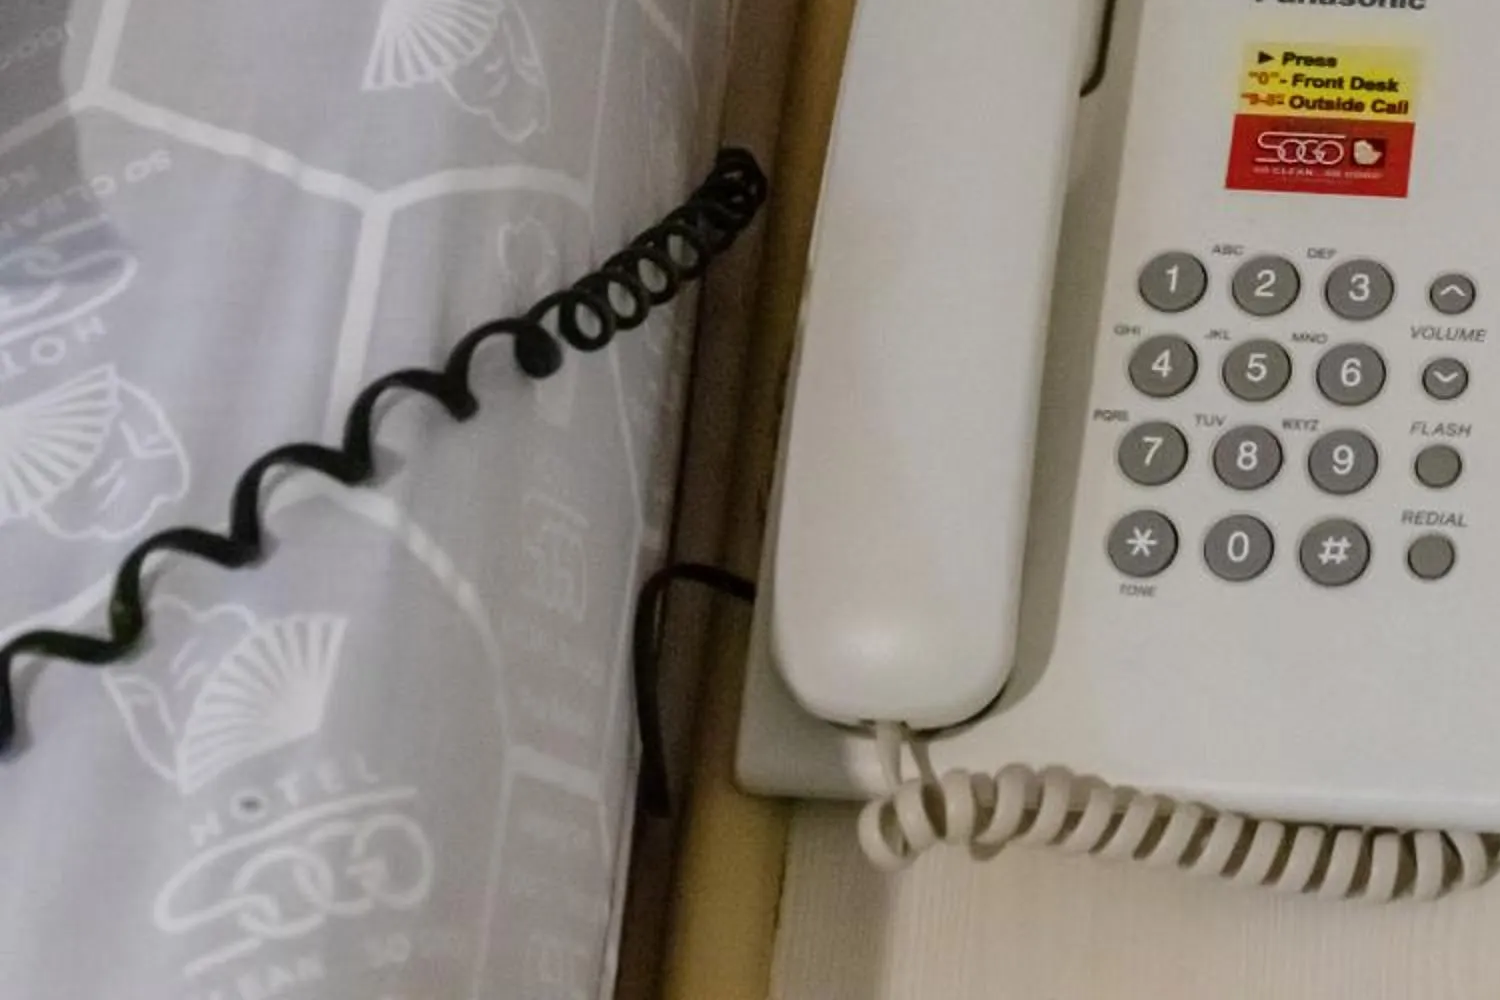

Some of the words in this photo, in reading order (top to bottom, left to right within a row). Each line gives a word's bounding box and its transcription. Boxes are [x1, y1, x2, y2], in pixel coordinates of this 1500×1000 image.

[1281, 51, 1338, 68] Press
[1291, 73, 1345, 90] Front
[1350, 76, 1399, 92] Desk
[1288, 95, 1365, 113] Outside
[1371, 99, 1409, 115] Call
[1254, 131, 1347, 165] SOGO
[1211, 243, 1245, 257] ABC
[1306, 247, 1337, 260] DEF
[1165, 264, 1180, 293] 1
[1255, 269, 1276, 297] 2
[1348, 273, 1370, 301] 3
[1113, 325, 1141, 337] GHI
[1204, 329, 1231, 341] JKL
[1291, 332, 1328, 344] MNO
[1410, 326, 1487, 343] VOLUME
[1151, 349, 1173, 378] 4
[1246, 353, 1267, 382] 5
[1340, 358, 1362, 387] 6
[1194, 414, 1226, 427] TUV
[1282, 419, 1320, 432] WXYZ
[1410, 421, 1472, 438] FLASH
[1142, 437, 1163, 466] 7
[1236, 441, 1258, 470] 8
[1332, 445, 1355, 474] 9
[1401, 510, 1468, 528] REDIAL
[1227, 531, 1250, 562] 0
[1119, 584, 1157, 598] TONE
